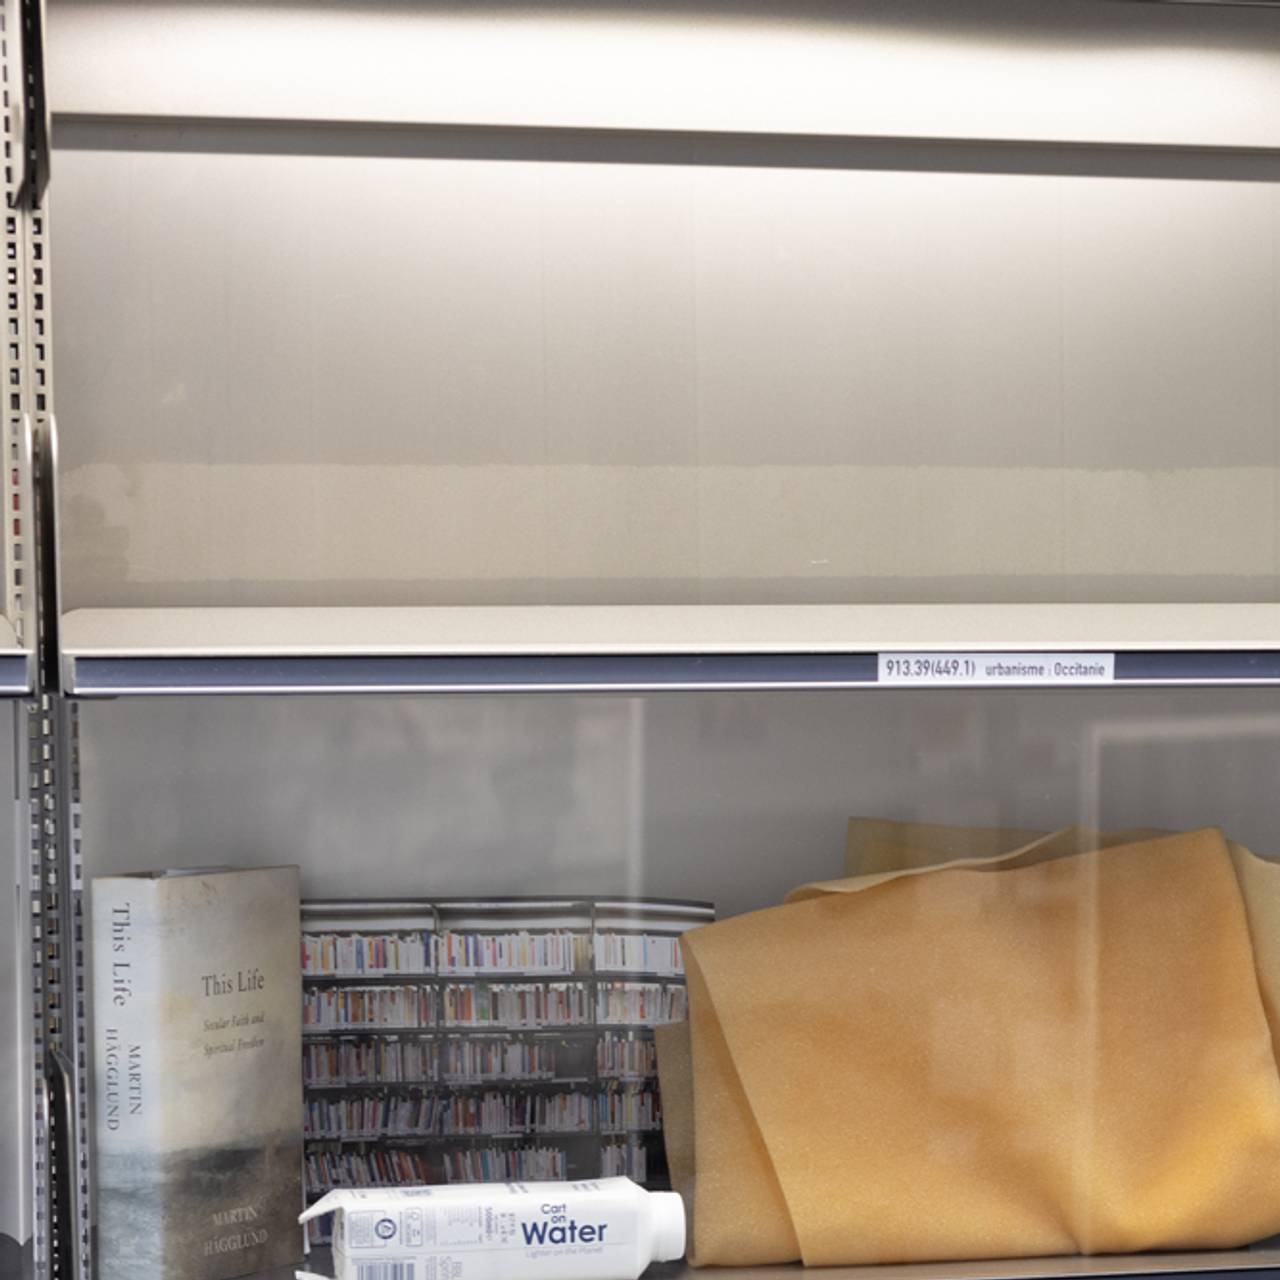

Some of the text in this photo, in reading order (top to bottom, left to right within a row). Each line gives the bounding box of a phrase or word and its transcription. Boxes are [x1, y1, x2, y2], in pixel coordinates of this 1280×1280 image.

[886, 659, 1105, 677] 913.39(449.1) urbanisme Occitanie
[112, 902, 132, 1006] This Life
[201, 969, 264, 997] This Life
[128, 1044, 143, 1115] MARTIN
[212, 1206, 257, 1226] MARTIN
[541, 1203, 566, 1214] Cart
[551, 1215, 566, 1224] on
[522, 1220, 608, 1245] Water
